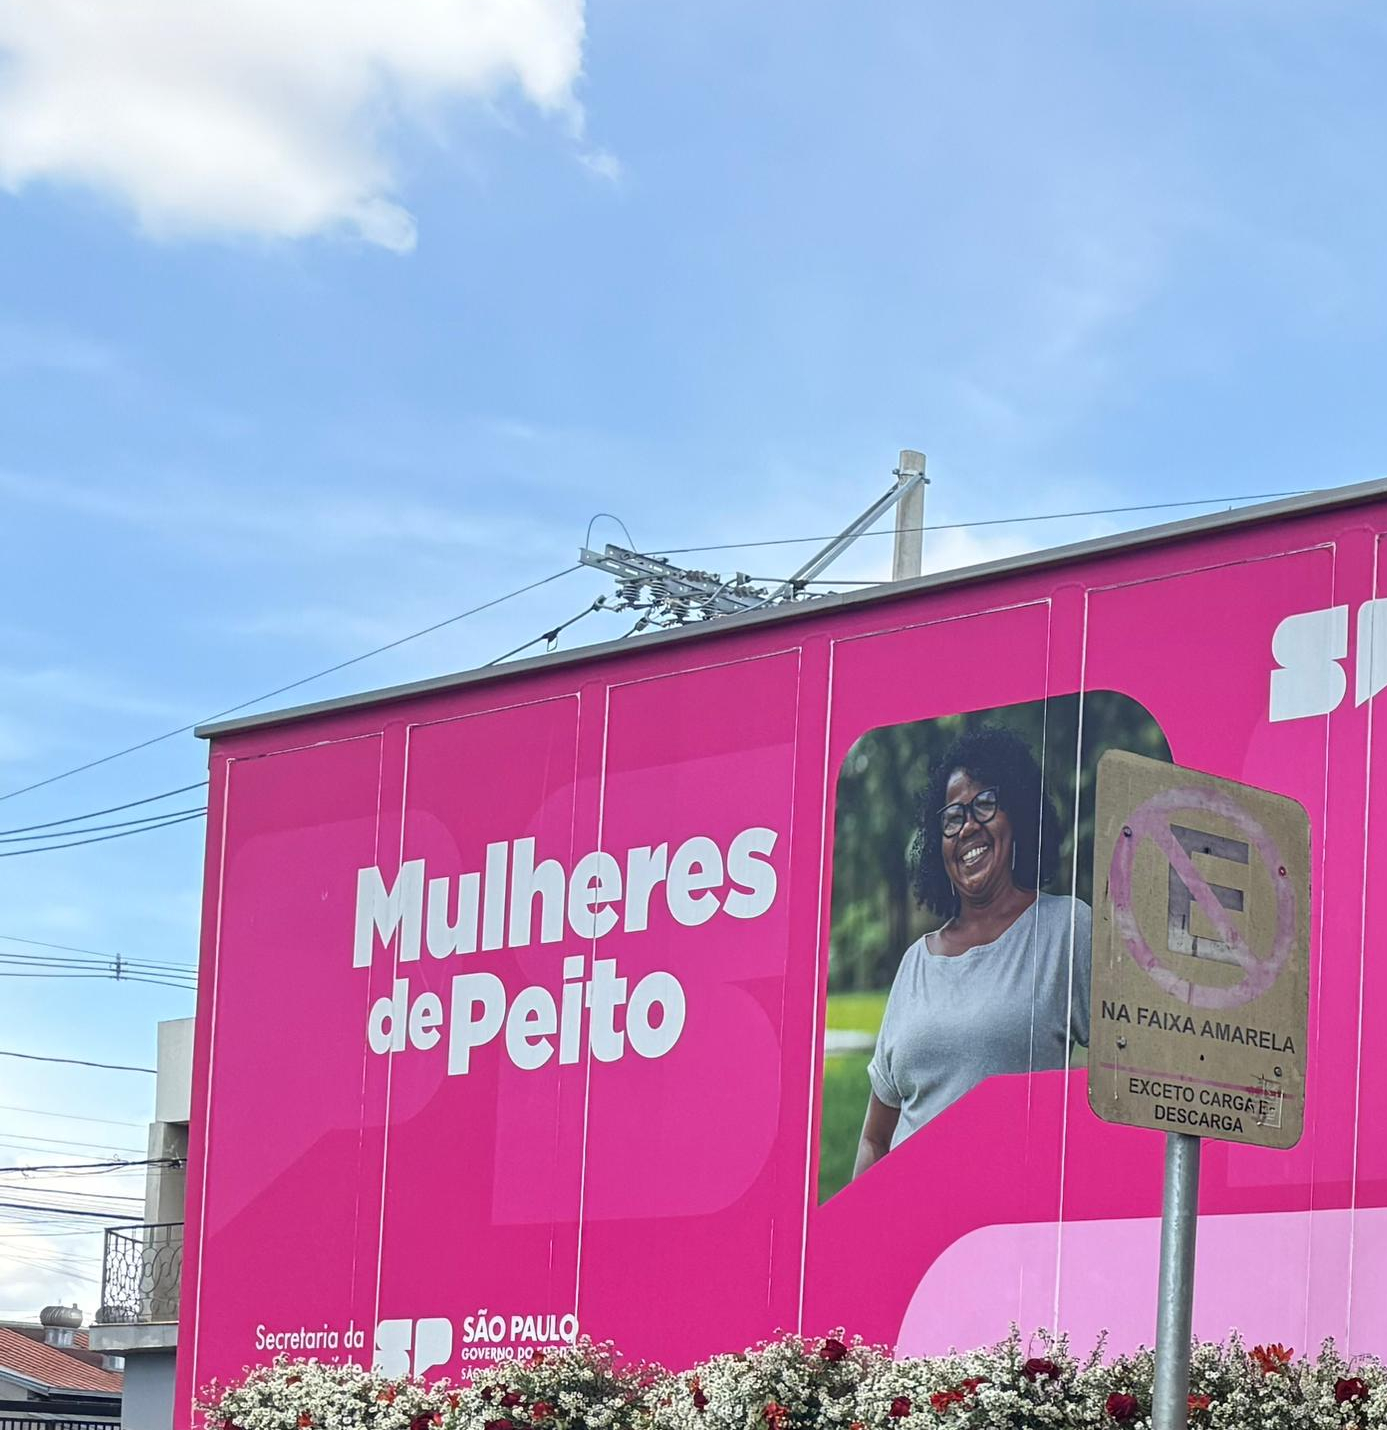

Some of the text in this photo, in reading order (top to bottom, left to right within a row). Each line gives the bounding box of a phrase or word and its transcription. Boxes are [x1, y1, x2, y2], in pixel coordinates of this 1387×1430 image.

[353, 826, 778, 968] Mulheres
[367, 958, 686, 1076] de Peito
[1102, 1000, 1295, 1054] NA FAIXA AMARELA
[1129, 1078, 1194, 1102] EXCETO
[1200, 1090, 1254, 1113] CARGA
[1155, 1105, 1243, 1133] DESCARGA
[256, 1320, 365, 1350] Secretaria da
[463, 1309, 579, 1343] SÃO PAULO
[461, 1347, 514, 1361] GOVERNO
[518, 1347, 534, 1360] DO
